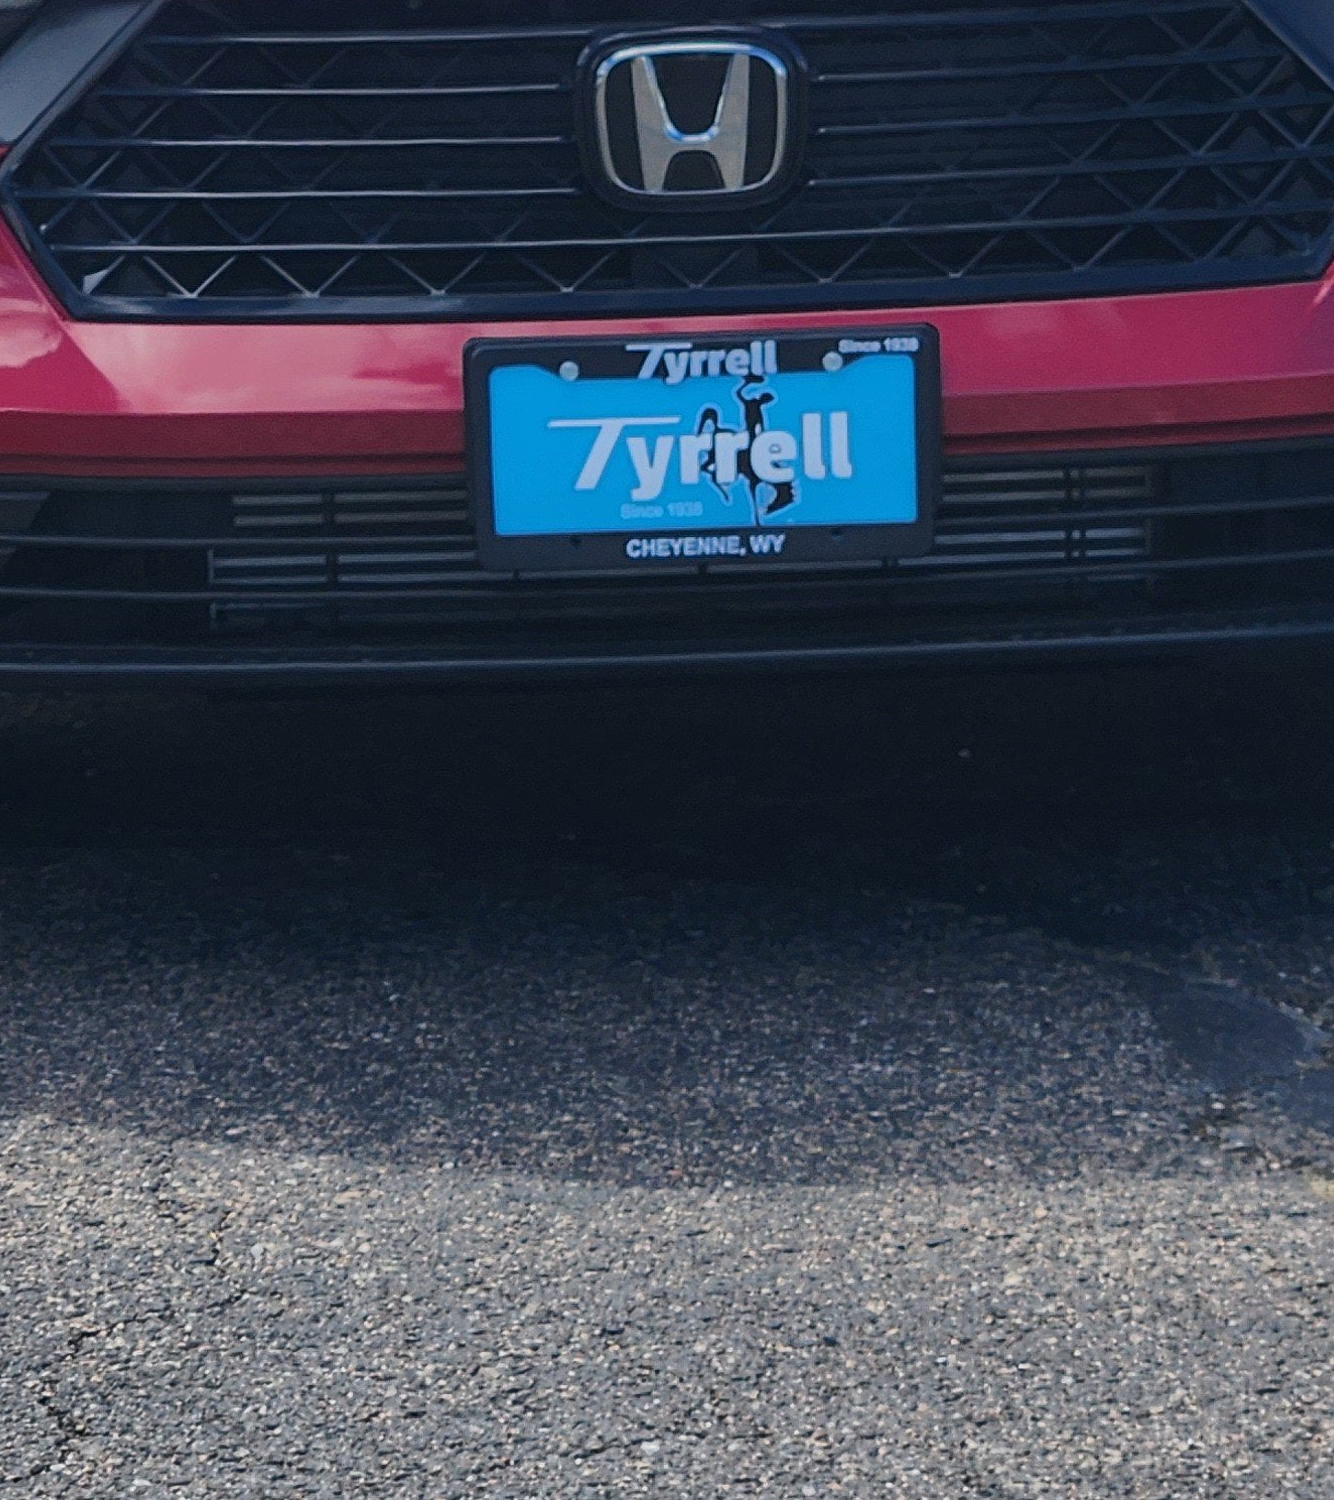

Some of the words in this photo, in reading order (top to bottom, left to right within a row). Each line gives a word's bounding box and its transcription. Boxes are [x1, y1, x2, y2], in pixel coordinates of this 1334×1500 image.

[625, 339, 778, 385] Tyrrell
[547, 411, 853, 501] Tyrrell
[625, 537, 746, 558] CHEYENNE,
[749, 534, 786, 554] WY
